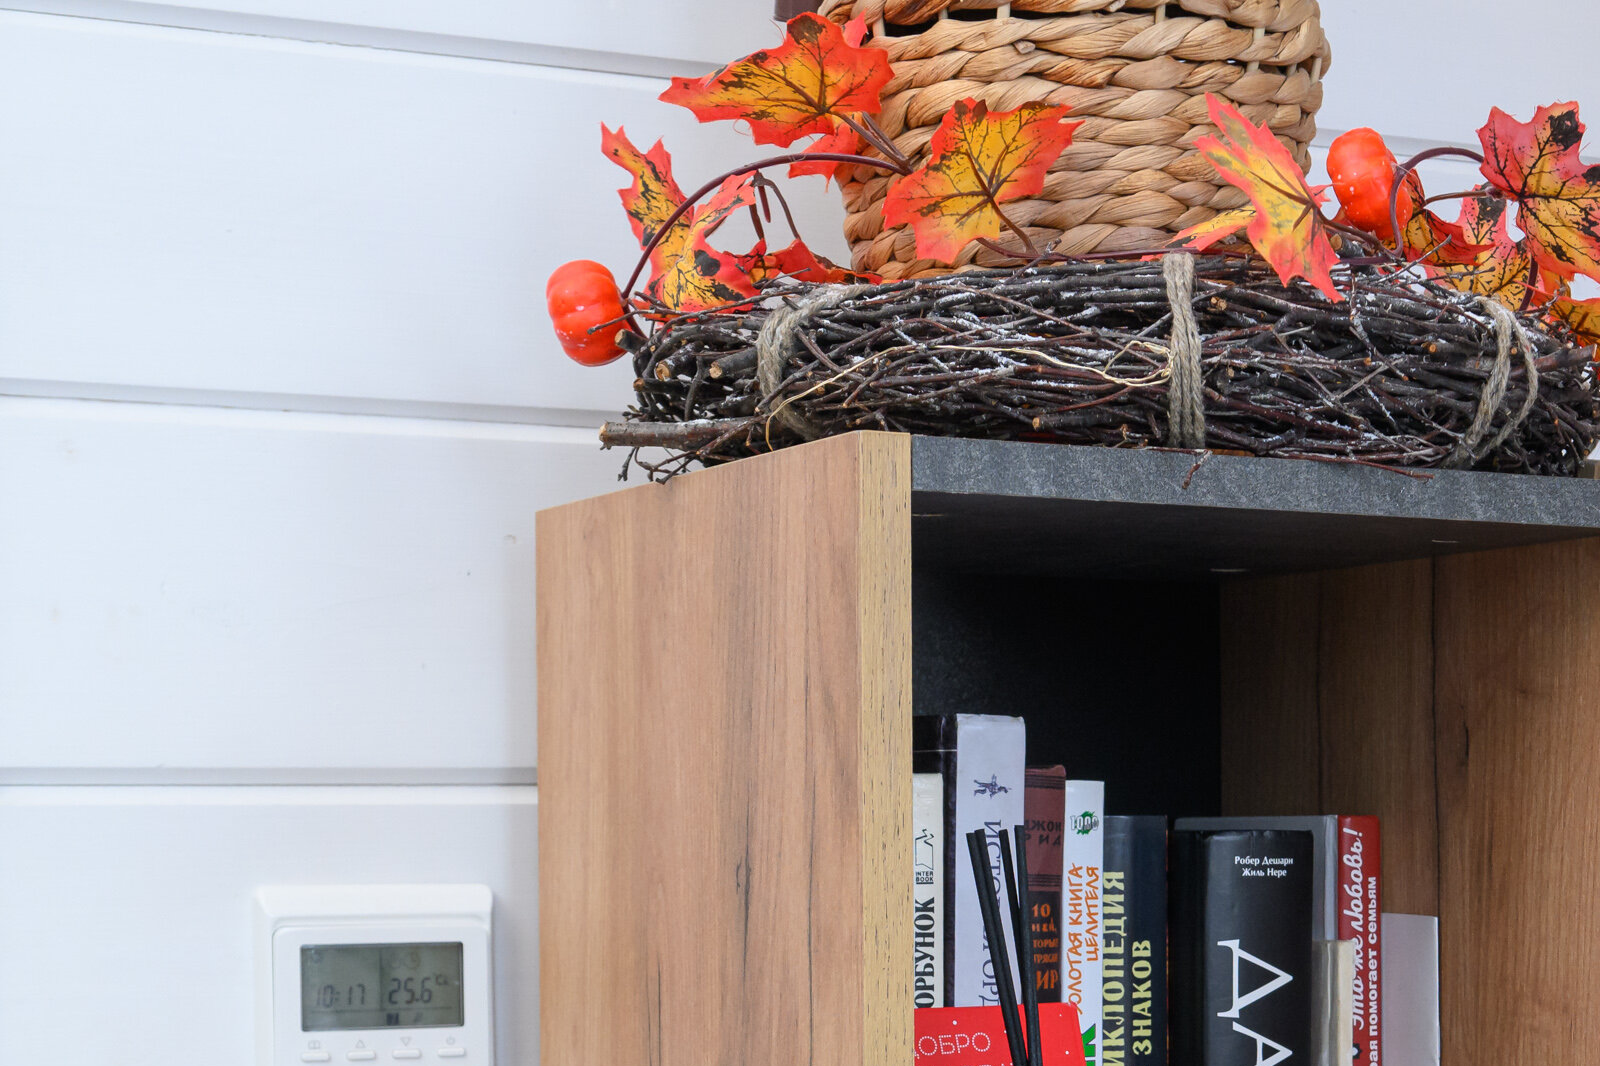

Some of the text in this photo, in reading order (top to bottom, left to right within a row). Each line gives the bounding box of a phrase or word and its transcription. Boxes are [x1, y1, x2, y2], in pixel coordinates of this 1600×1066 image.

[1234, 856, 1260, 867] Робер
[1242, 867, 1287, 878] Жиль Нере
[1343, 827, 1364, 932] любовь!
[1032, 903, 1051, 918] 10
[1084, 866, 1100, 962] ЦЕЛИТЕЛЯ
[1367, 876, 1378, 945] семьям
[914, 896, 935, 1008] ОРБУНОК
[1066, 862, 1084, 1014] ОЛОТАЯ КНИГА
[308, 984, 366, 1008] 10:17
[388, 976, 423, 1005] 25.6
[1036, 969, 1059, 991] ИР
[1132, 939, 1153, 1057] ЗНАКОВ
[1367, 948, 1379, 1036] помогает
[914, 1031, 991, 1059] ОБРО
